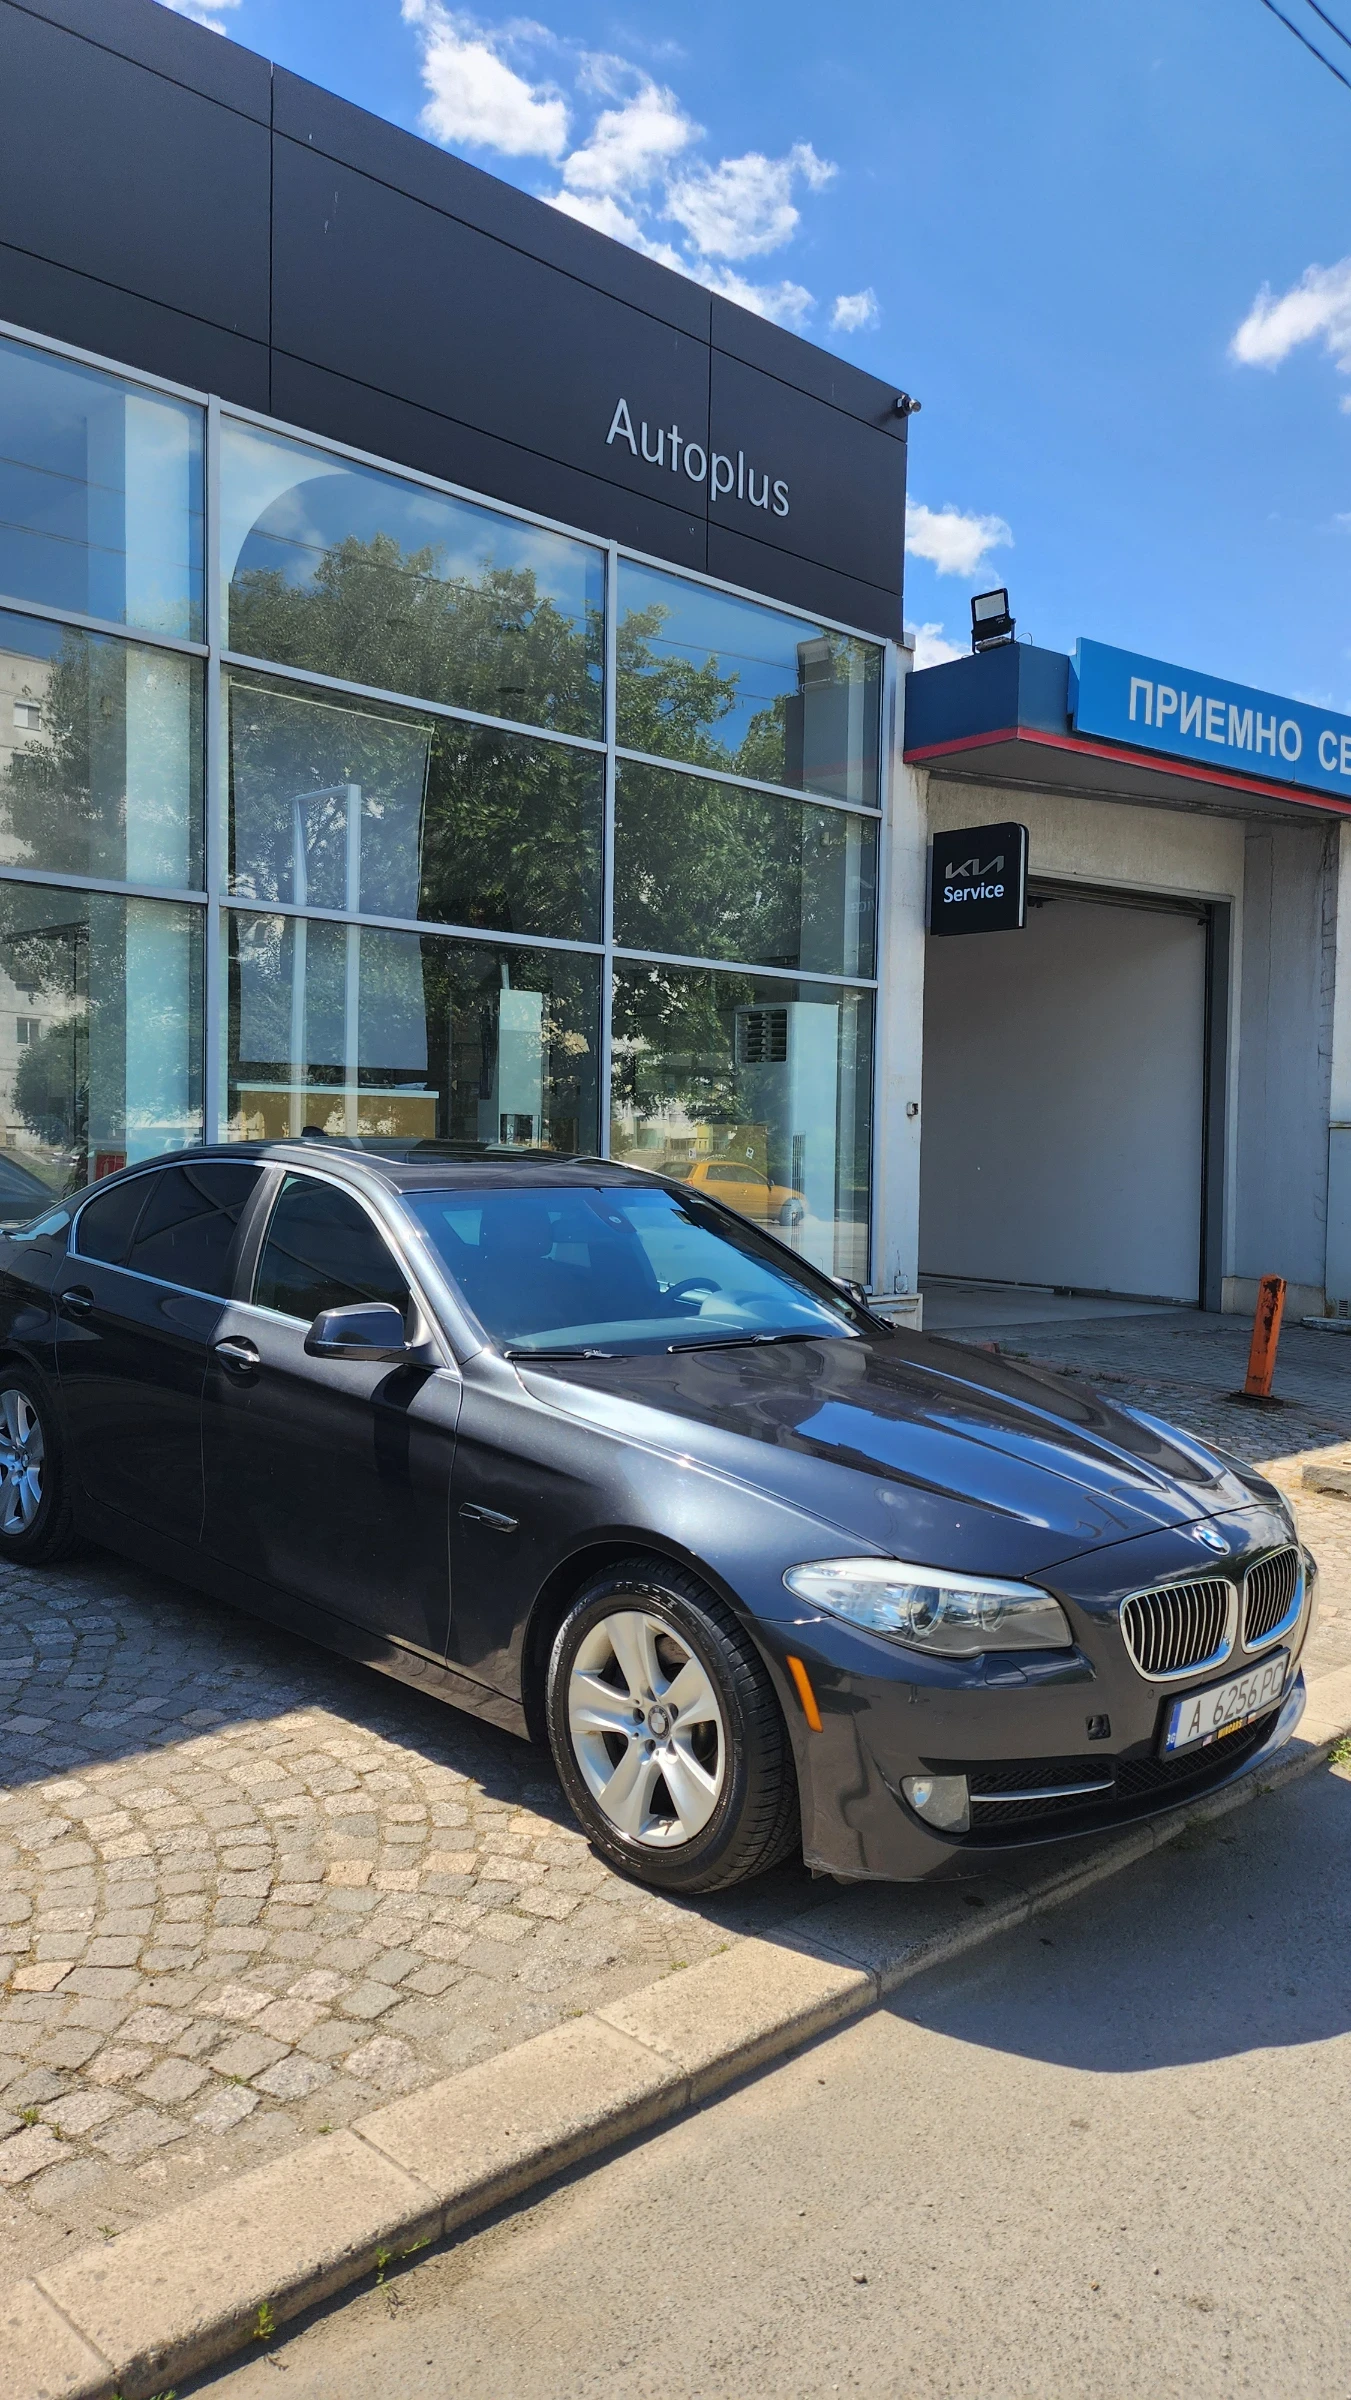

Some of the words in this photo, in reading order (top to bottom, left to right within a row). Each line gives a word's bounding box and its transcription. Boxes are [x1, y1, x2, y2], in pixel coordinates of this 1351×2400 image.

[605, 397, 790, 517] Autoplus
[1129, 676, 1302, 762] ПРИЕМНО
[943, 882, 1005, 903] Service
[945, 855, 1005, 880] KIA
[1187, 1700, 1202, 1738] A
[1212, 1674, 1258, 1726] 6256
